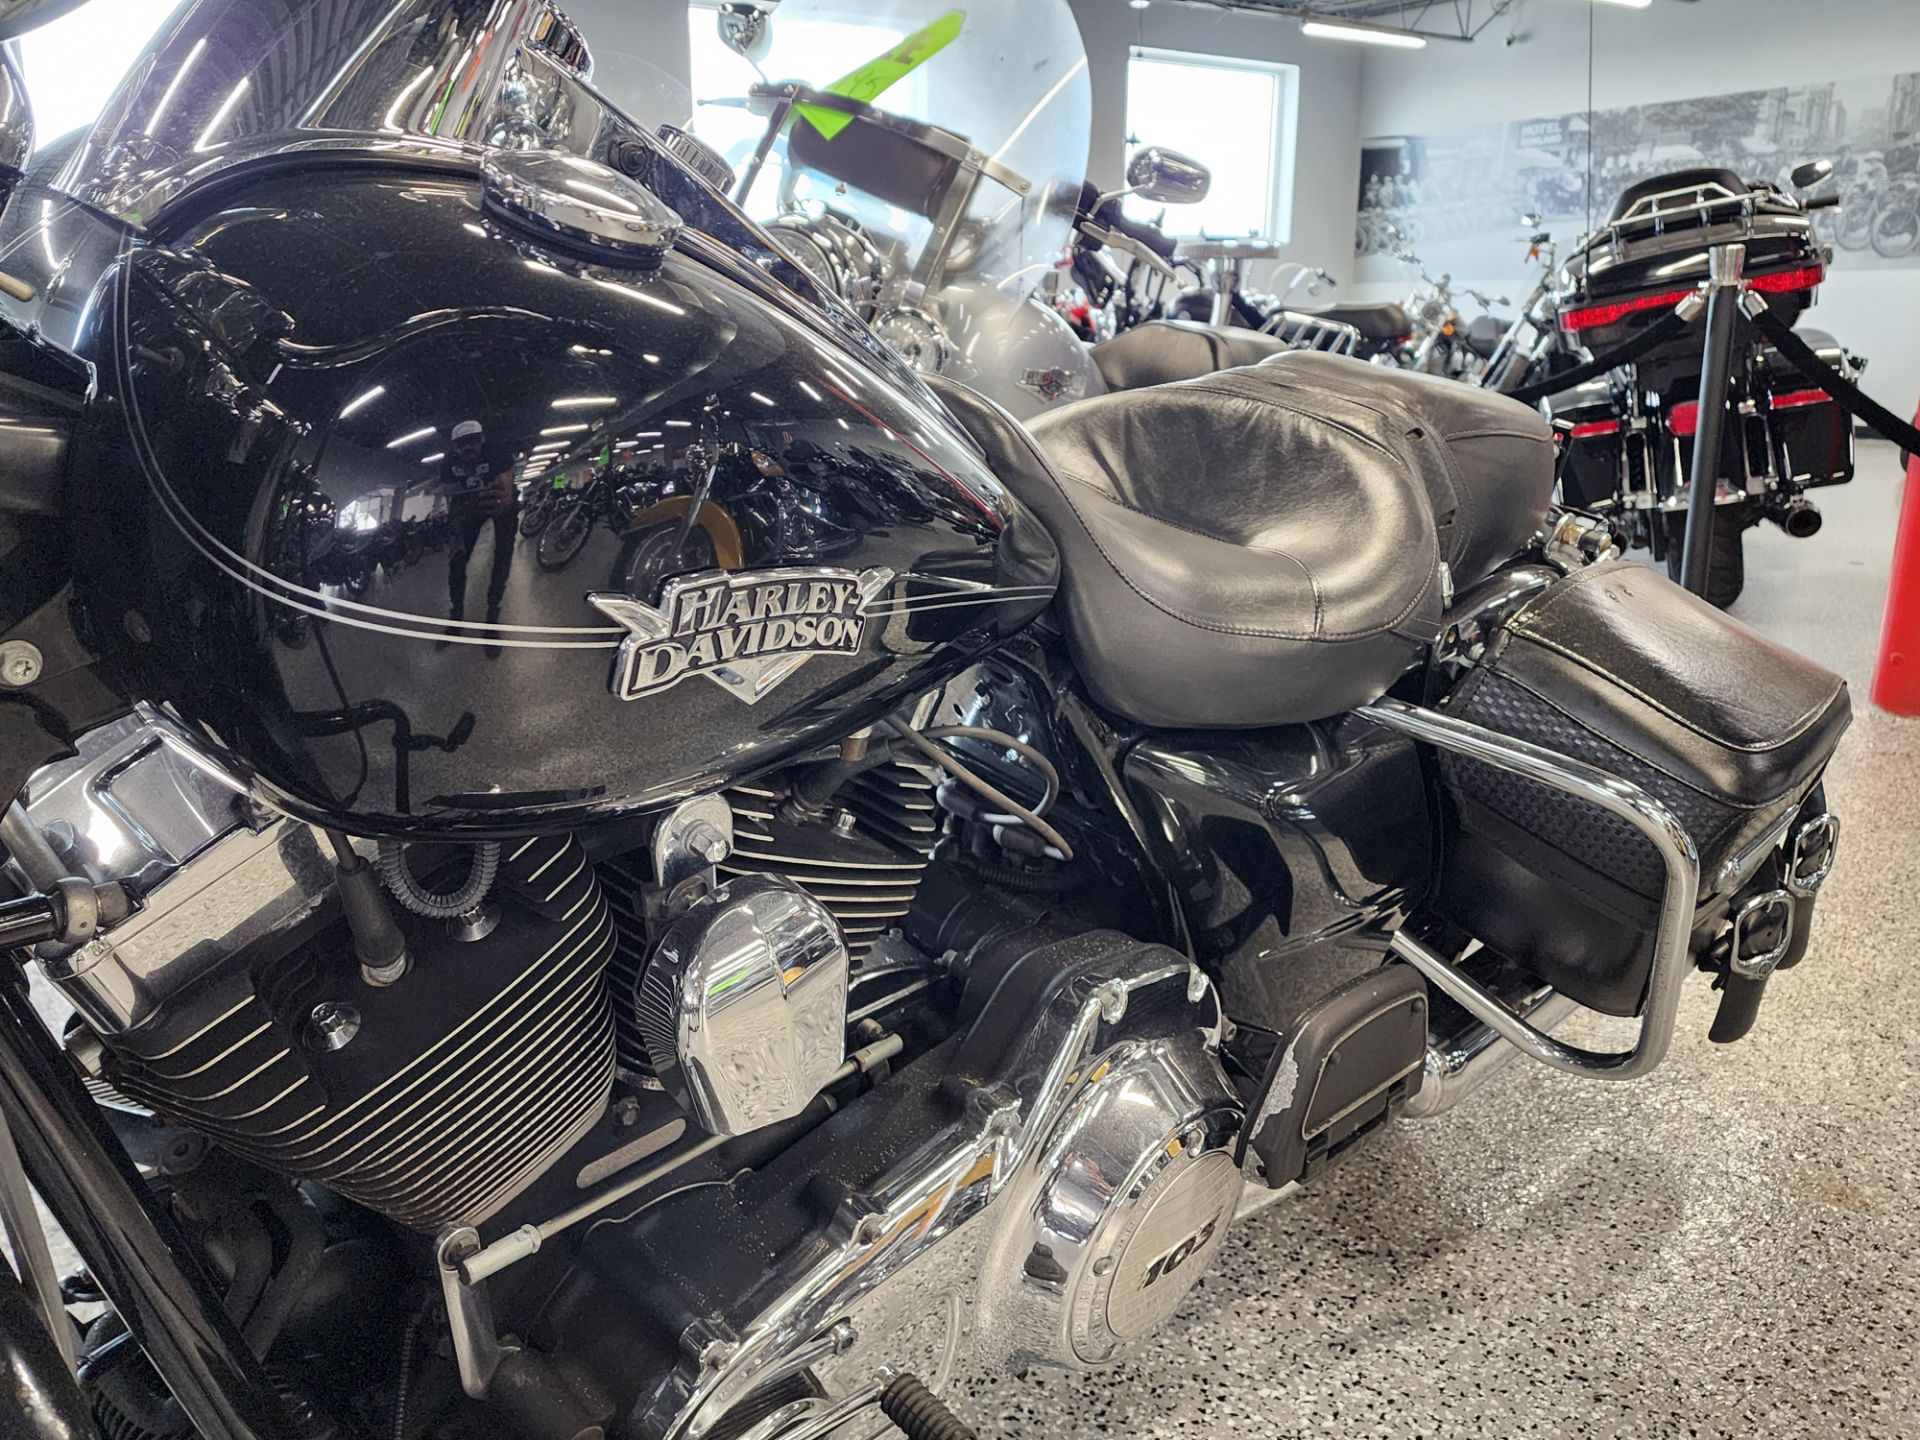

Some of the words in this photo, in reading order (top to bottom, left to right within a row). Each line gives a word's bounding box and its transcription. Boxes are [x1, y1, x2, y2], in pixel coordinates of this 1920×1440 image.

[675, 582, 858, 637] HARLEY-
[633, 616, 863, 689] DAVIDSON
[1138, 1205, 1223, 1291] 103
